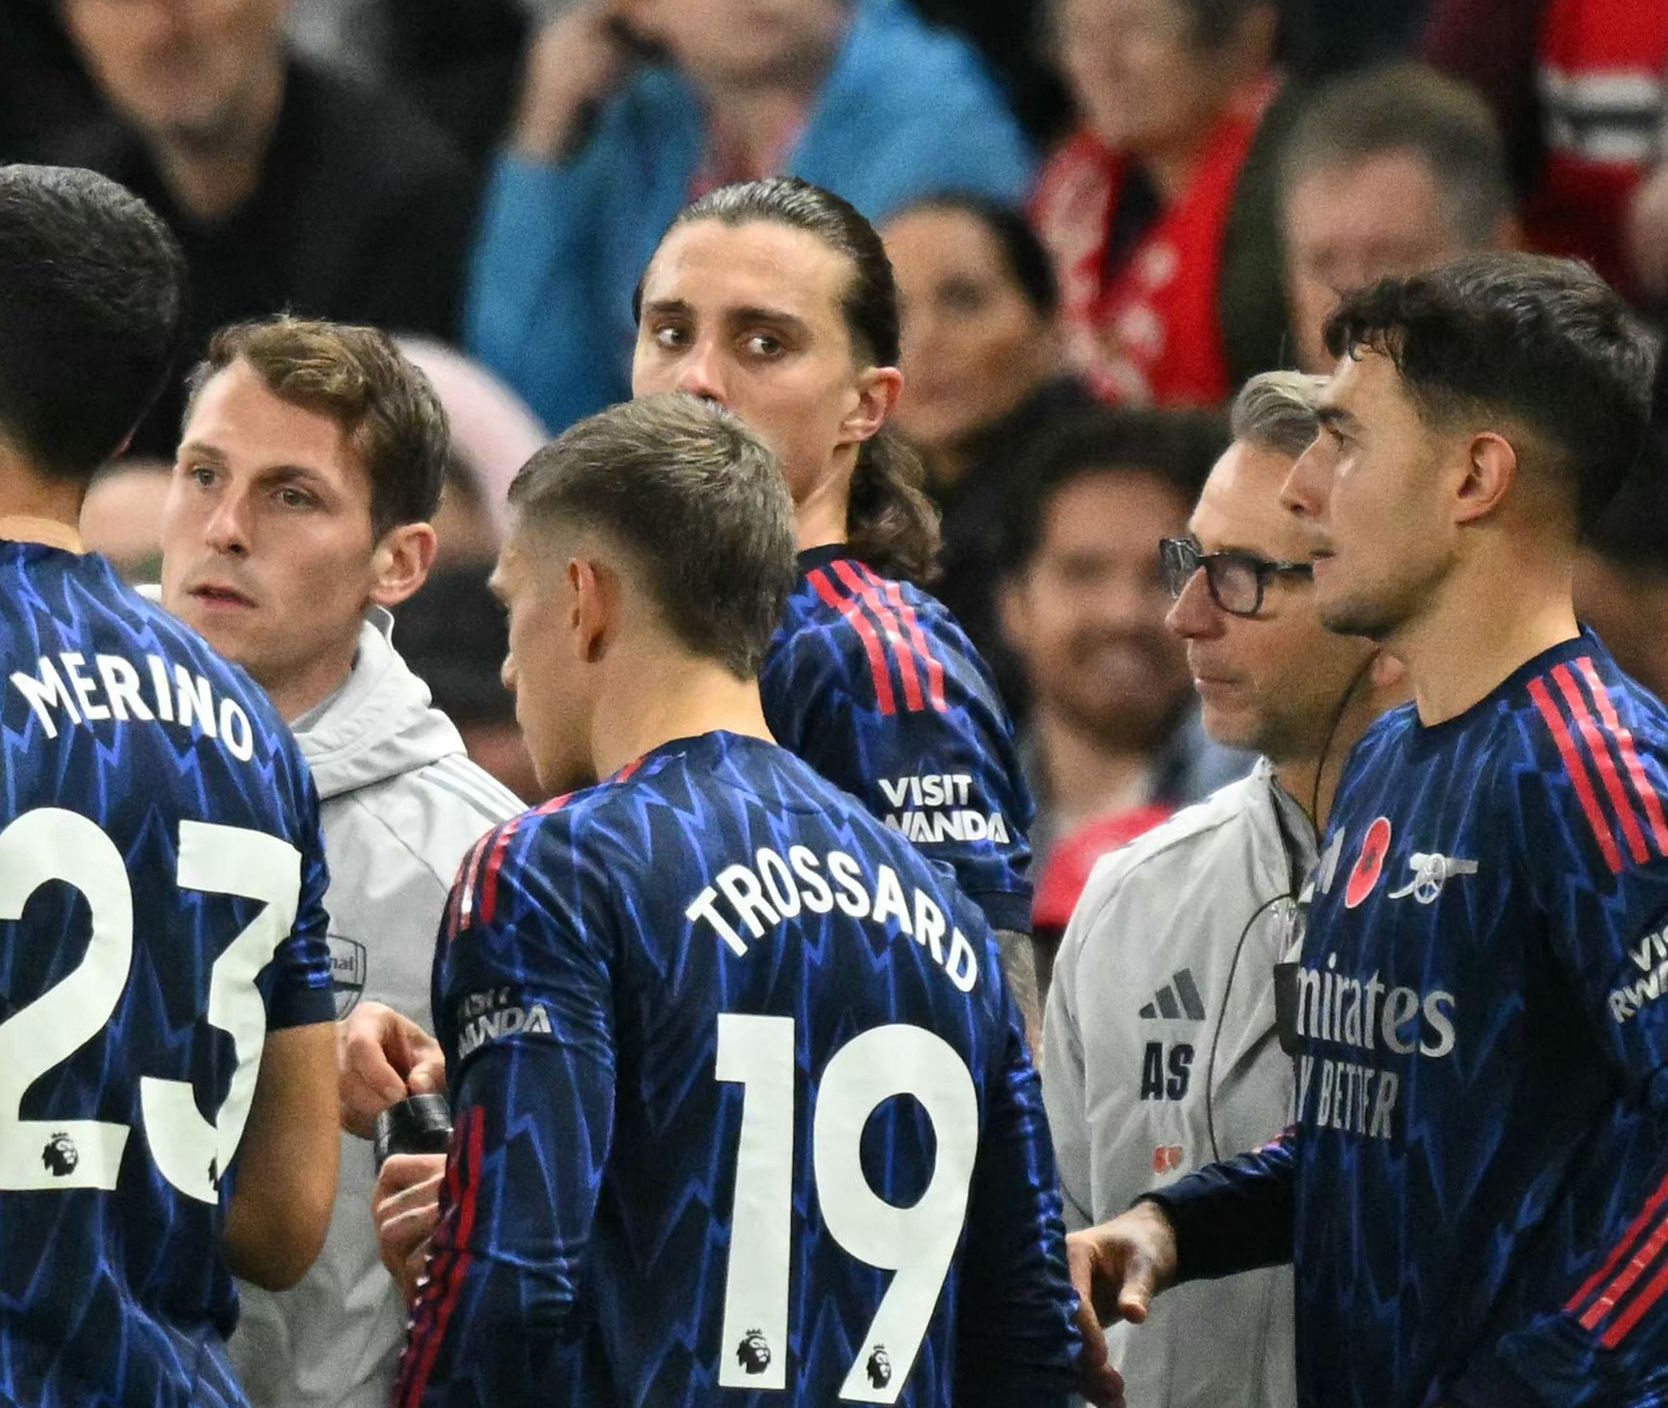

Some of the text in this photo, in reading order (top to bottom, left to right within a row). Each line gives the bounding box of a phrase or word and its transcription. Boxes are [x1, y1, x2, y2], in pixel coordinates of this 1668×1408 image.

[11, 651, 255, 762] MERINO
[878, 774, 972, 807] VISIT
[686, 845, 978, 993] TROSSARD
[1297, 952, 1456, 1058] mirates
[1141, 1042, 1194, 1101] AS
[715, 1013, 978, 1404] 19
